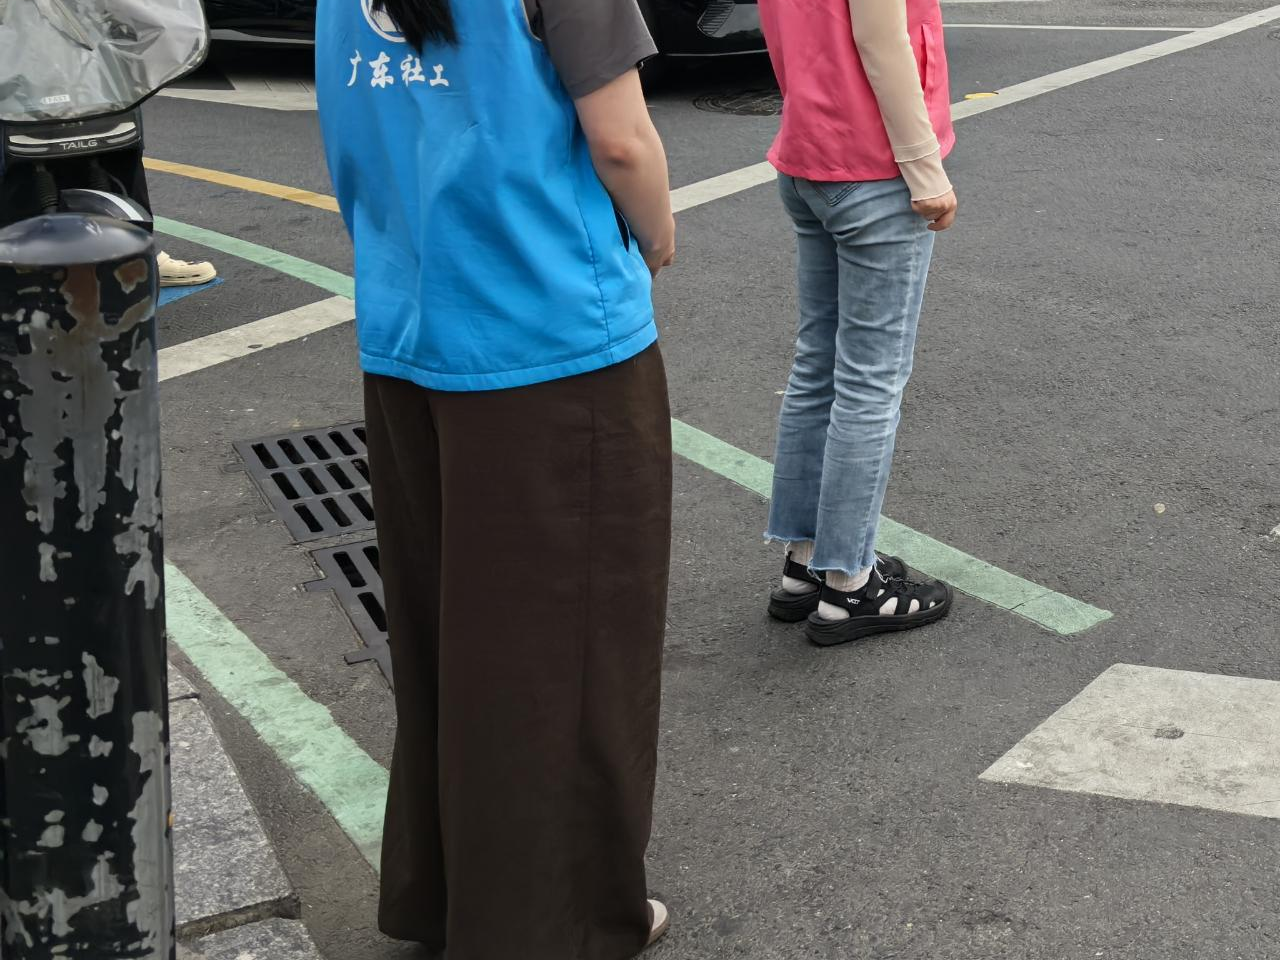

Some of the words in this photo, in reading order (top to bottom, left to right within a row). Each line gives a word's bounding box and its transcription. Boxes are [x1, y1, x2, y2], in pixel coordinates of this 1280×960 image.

[347, 49, 449, 88] 广东社工
[59, 139, 98, 151] TAILG
